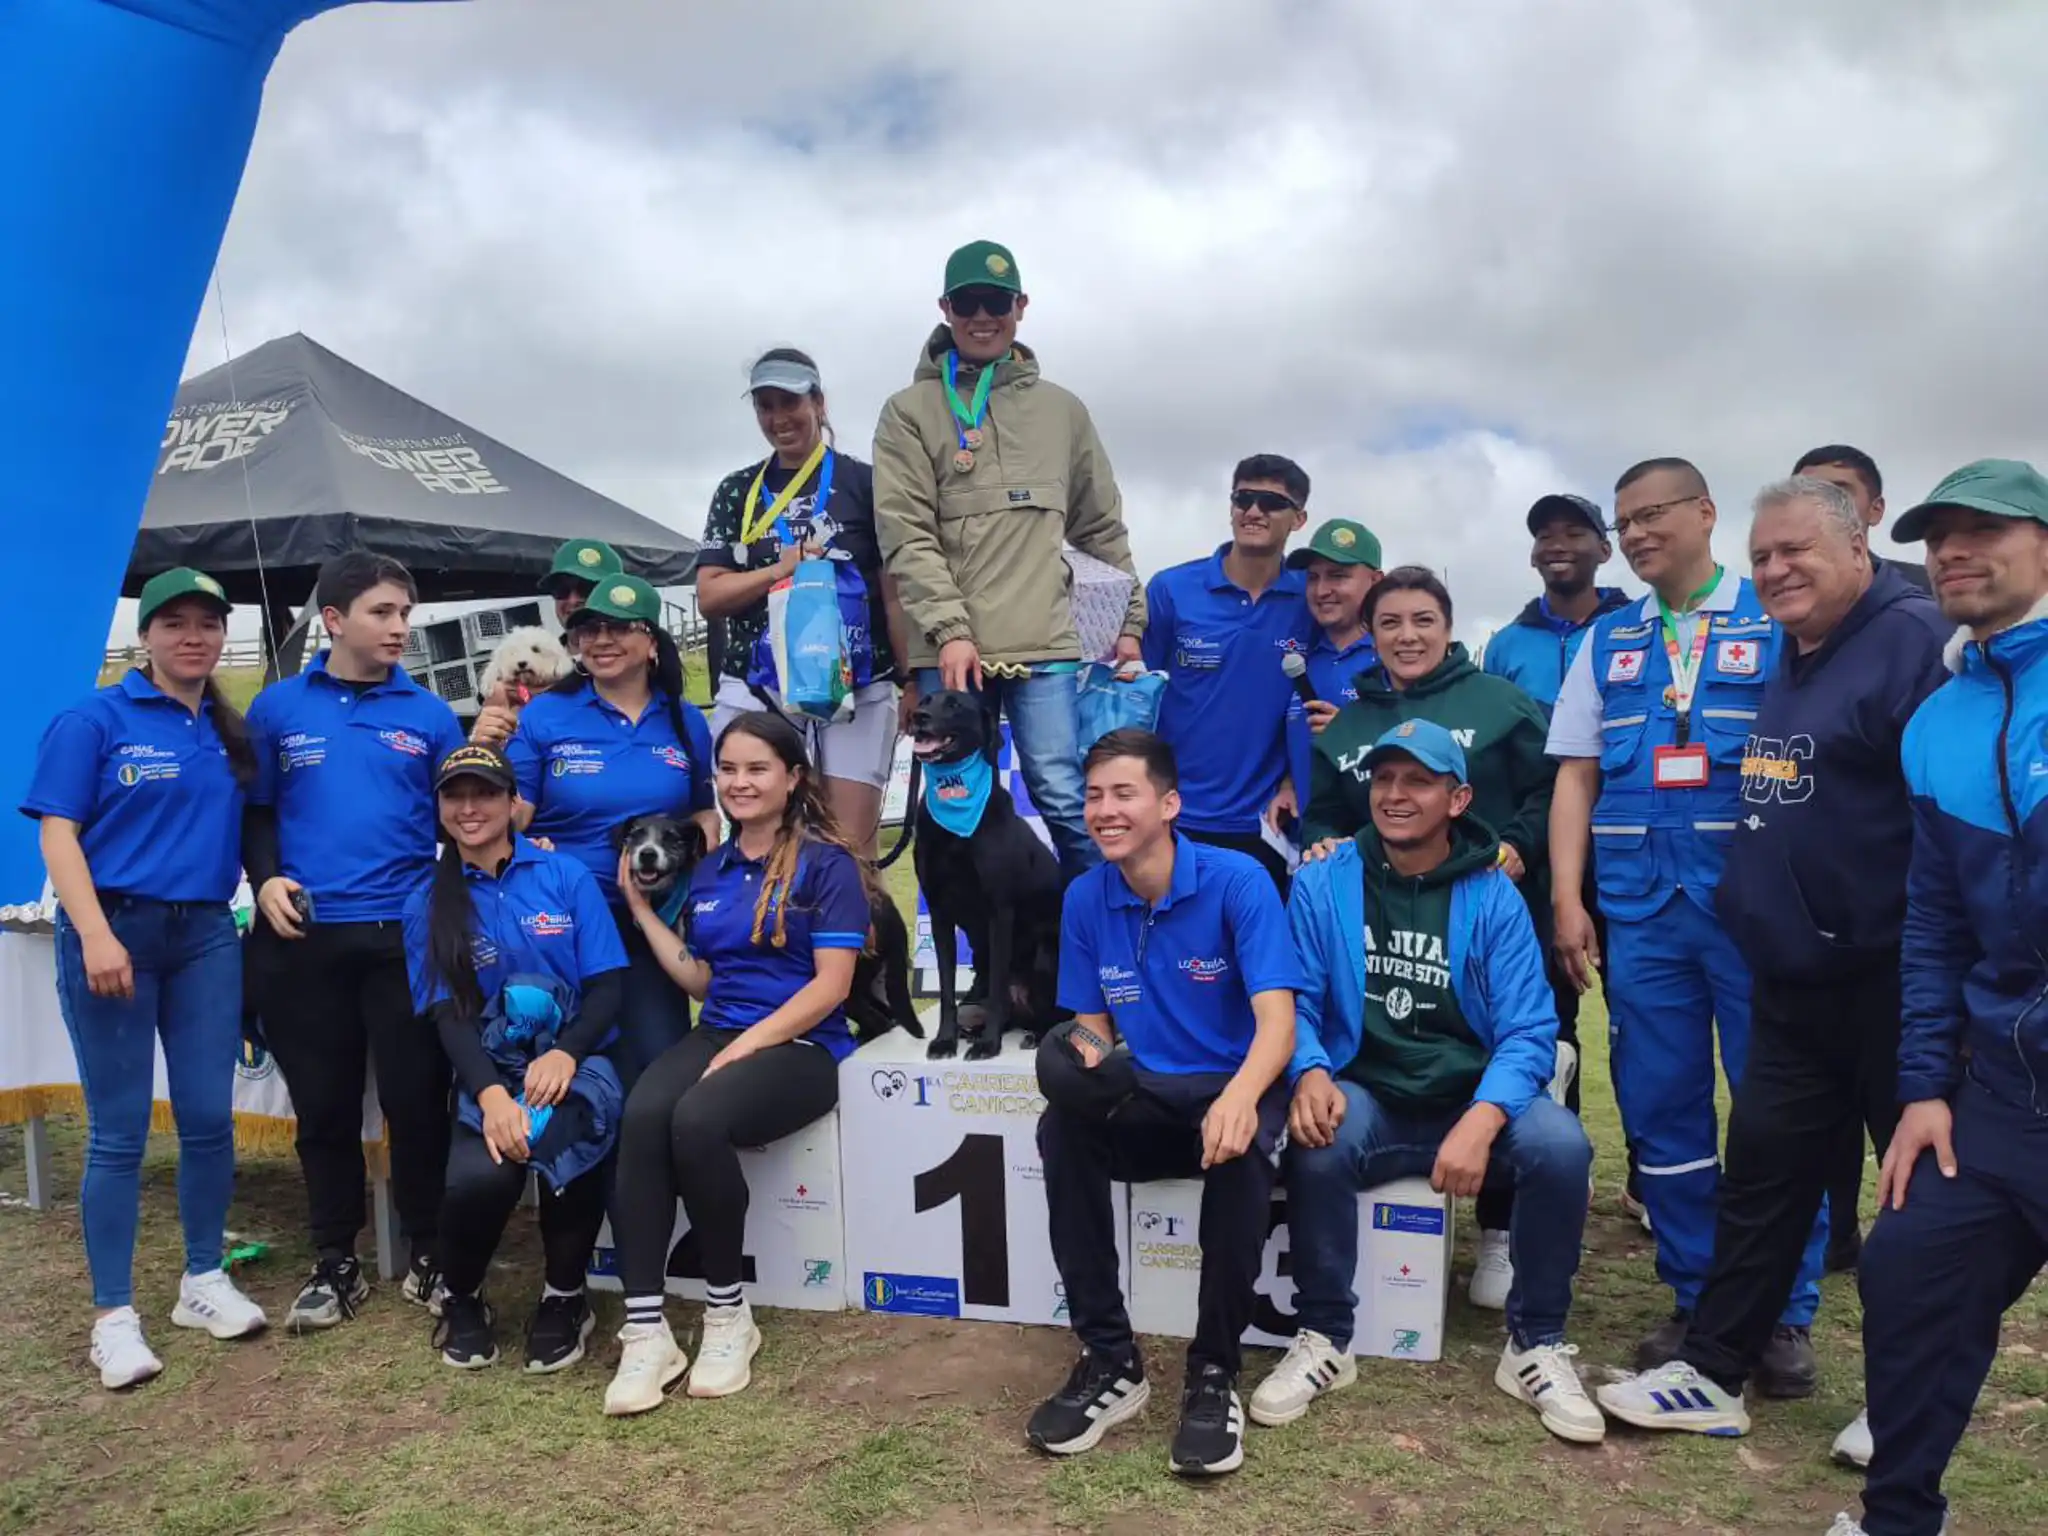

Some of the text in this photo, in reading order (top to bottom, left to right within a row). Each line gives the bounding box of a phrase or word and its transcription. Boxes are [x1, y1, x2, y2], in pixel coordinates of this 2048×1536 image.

[1388, 930, 1449, 967] JUA
[1364, 954, 1451, 988] NIVERSITY
[914, 1134, 1010, 1306] 1
